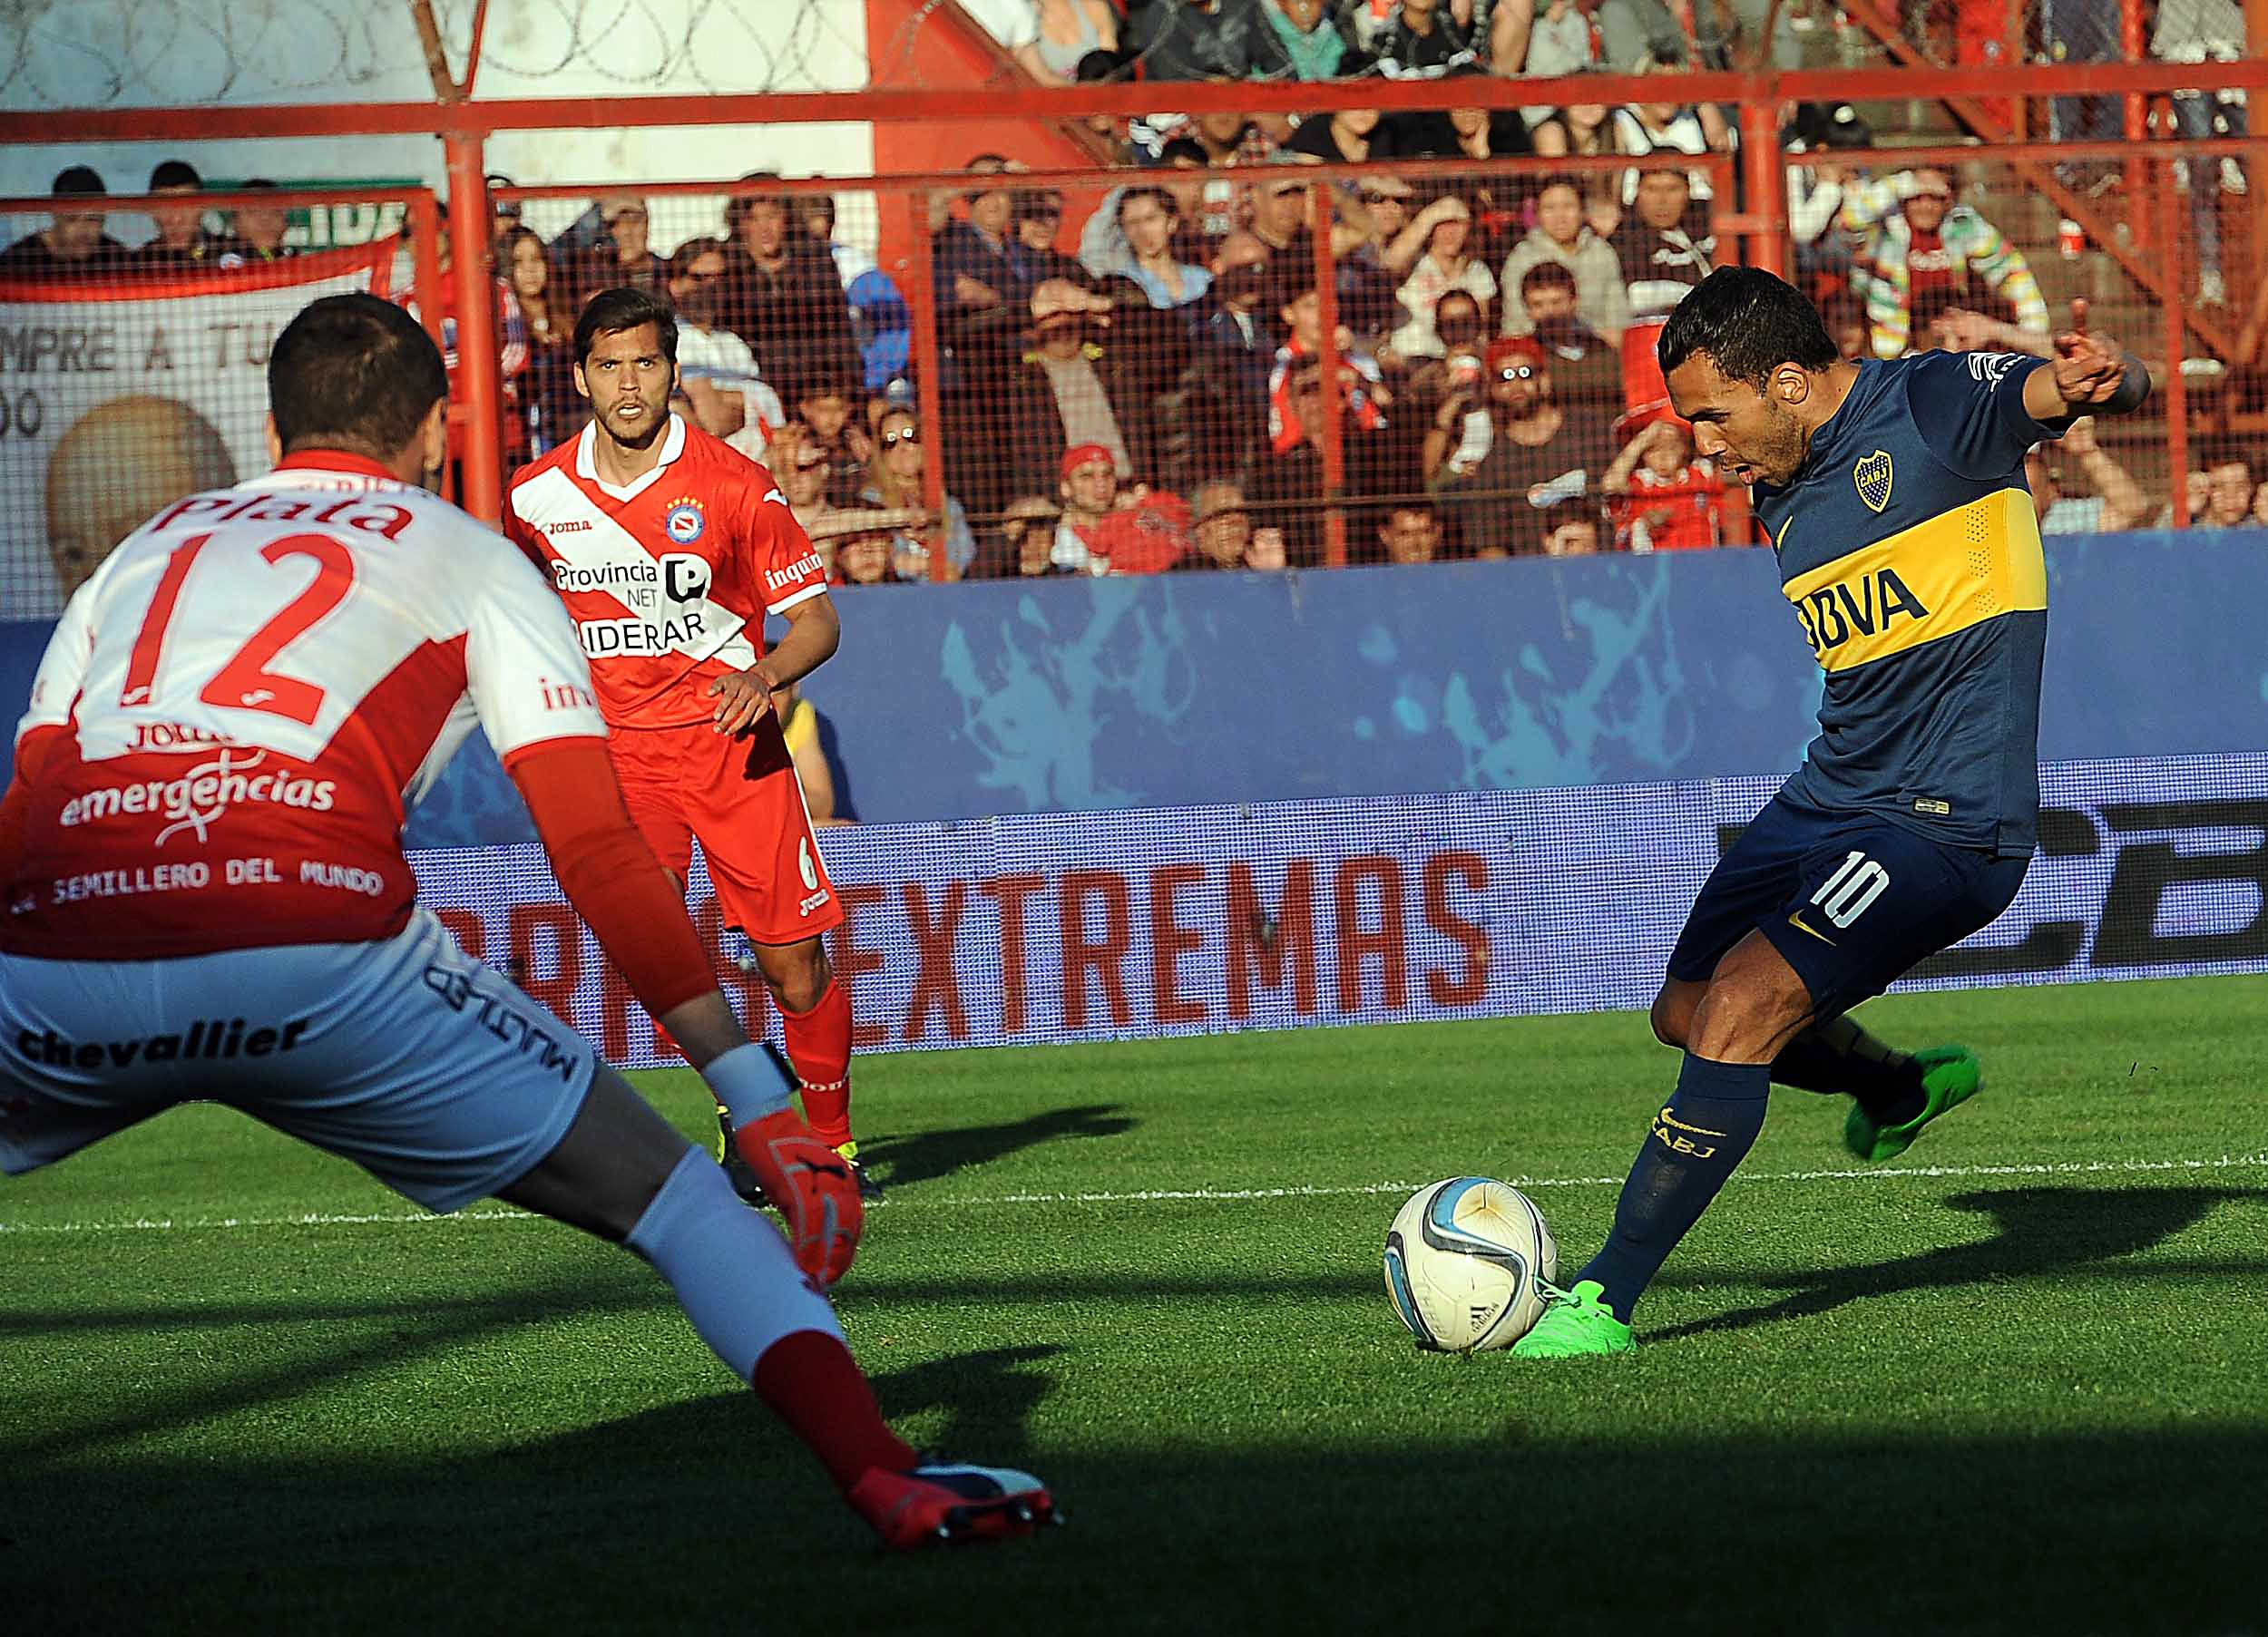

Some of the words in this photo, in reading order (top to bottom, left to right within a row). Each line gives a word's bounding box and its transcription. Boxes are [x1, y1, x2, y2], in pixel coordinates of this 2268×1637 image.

[144, 324, 174, 370] A
[150, 494, 414, 541] Plata
[556, 560, 658, 586] Provincia
[627, 590, 658, 608] NET
[121, 531, 355, 726] 12
[580, 612, 704, 652] IDERAR
[60, 764, 337, 829] emergencias
[51, 862, 210, 905] SEMILLERO
[225, 858, 282, 885] DEL
[299, 860, 385, 898] MUNDO
[798, 835, 818, 891] 6
[1810, 849, 1890, 930] 10
[834, 849, 1492, 1049] EXTREMAS
